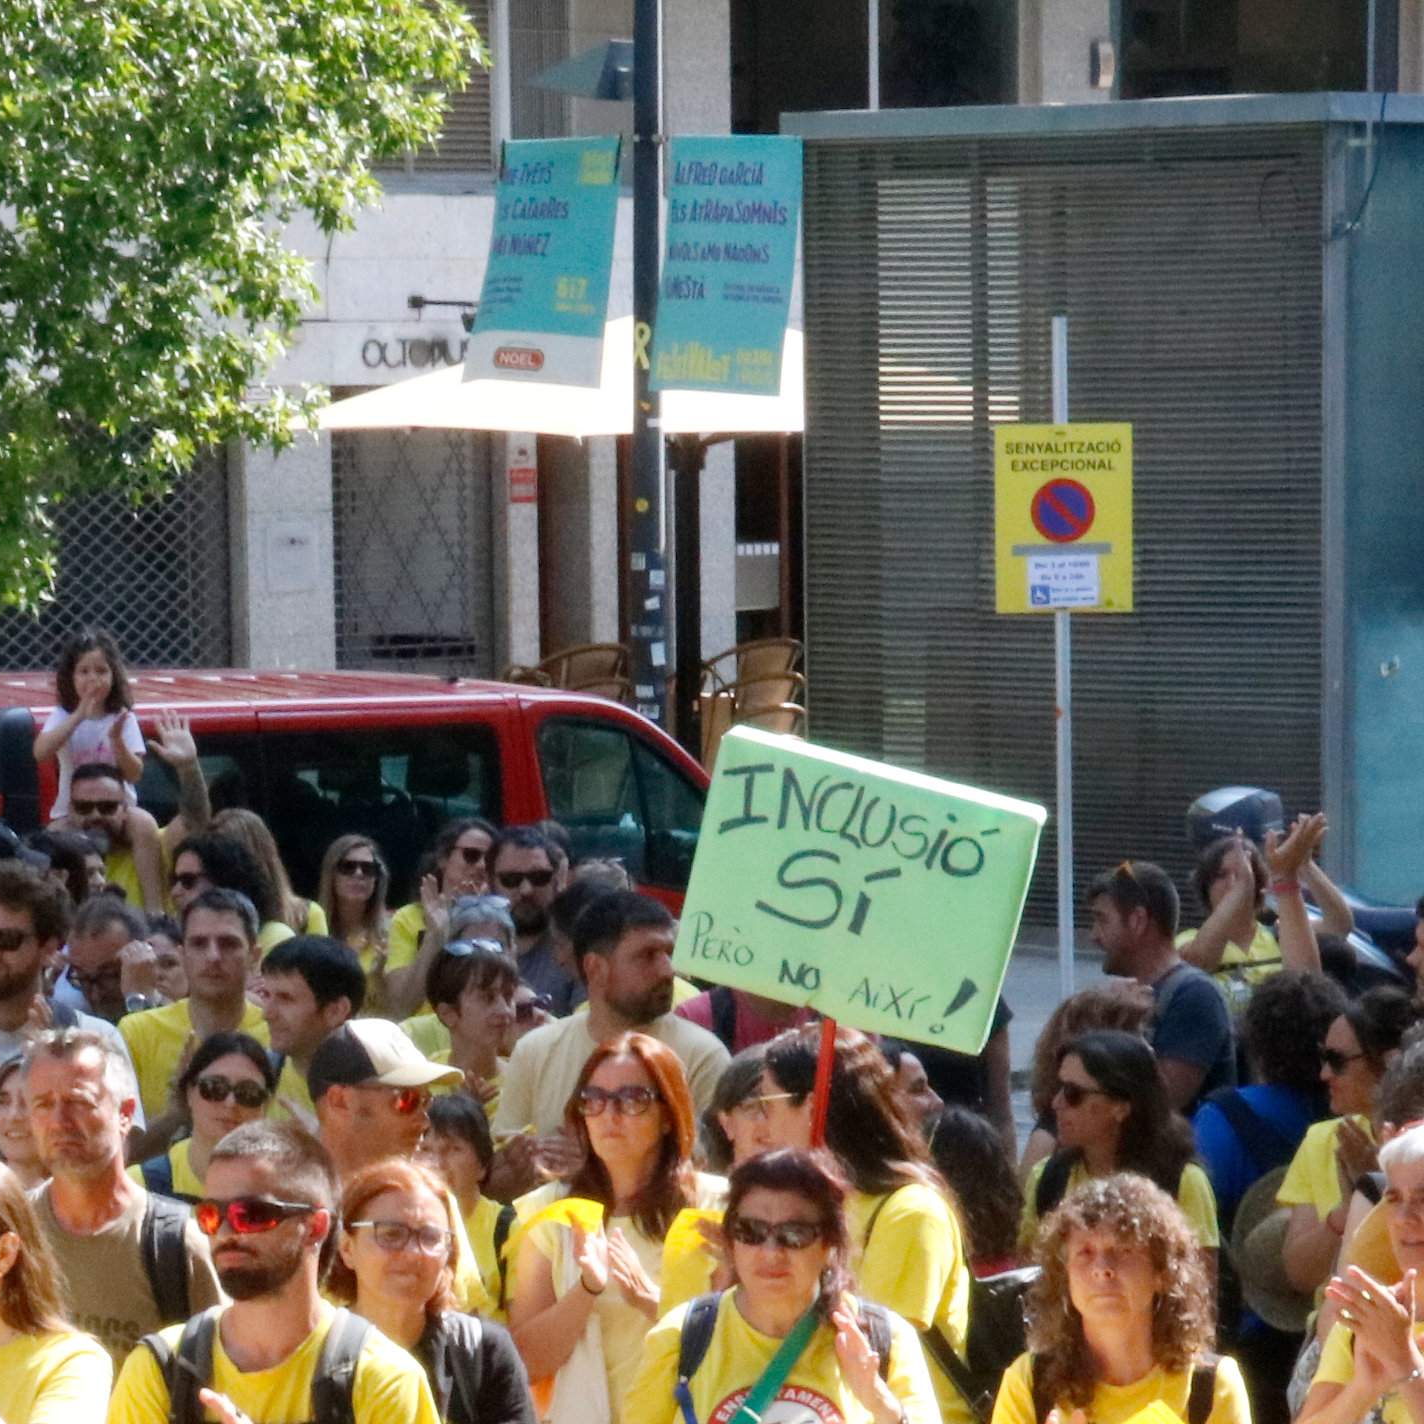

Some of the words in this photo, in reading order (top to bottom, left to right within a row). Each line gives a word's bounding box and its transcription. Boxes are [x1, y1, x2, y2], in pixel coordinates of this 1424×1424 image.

[498, 351, 536, 367] NOEL
[1005, 437, 1121, 455] SENYALITZACIÓ
[1010, 458, 1115, 472] EXCEPCIONAL
[718, 763, 1000, 878] INCLUSIÓ
[779, 959, 821, 992] NO
